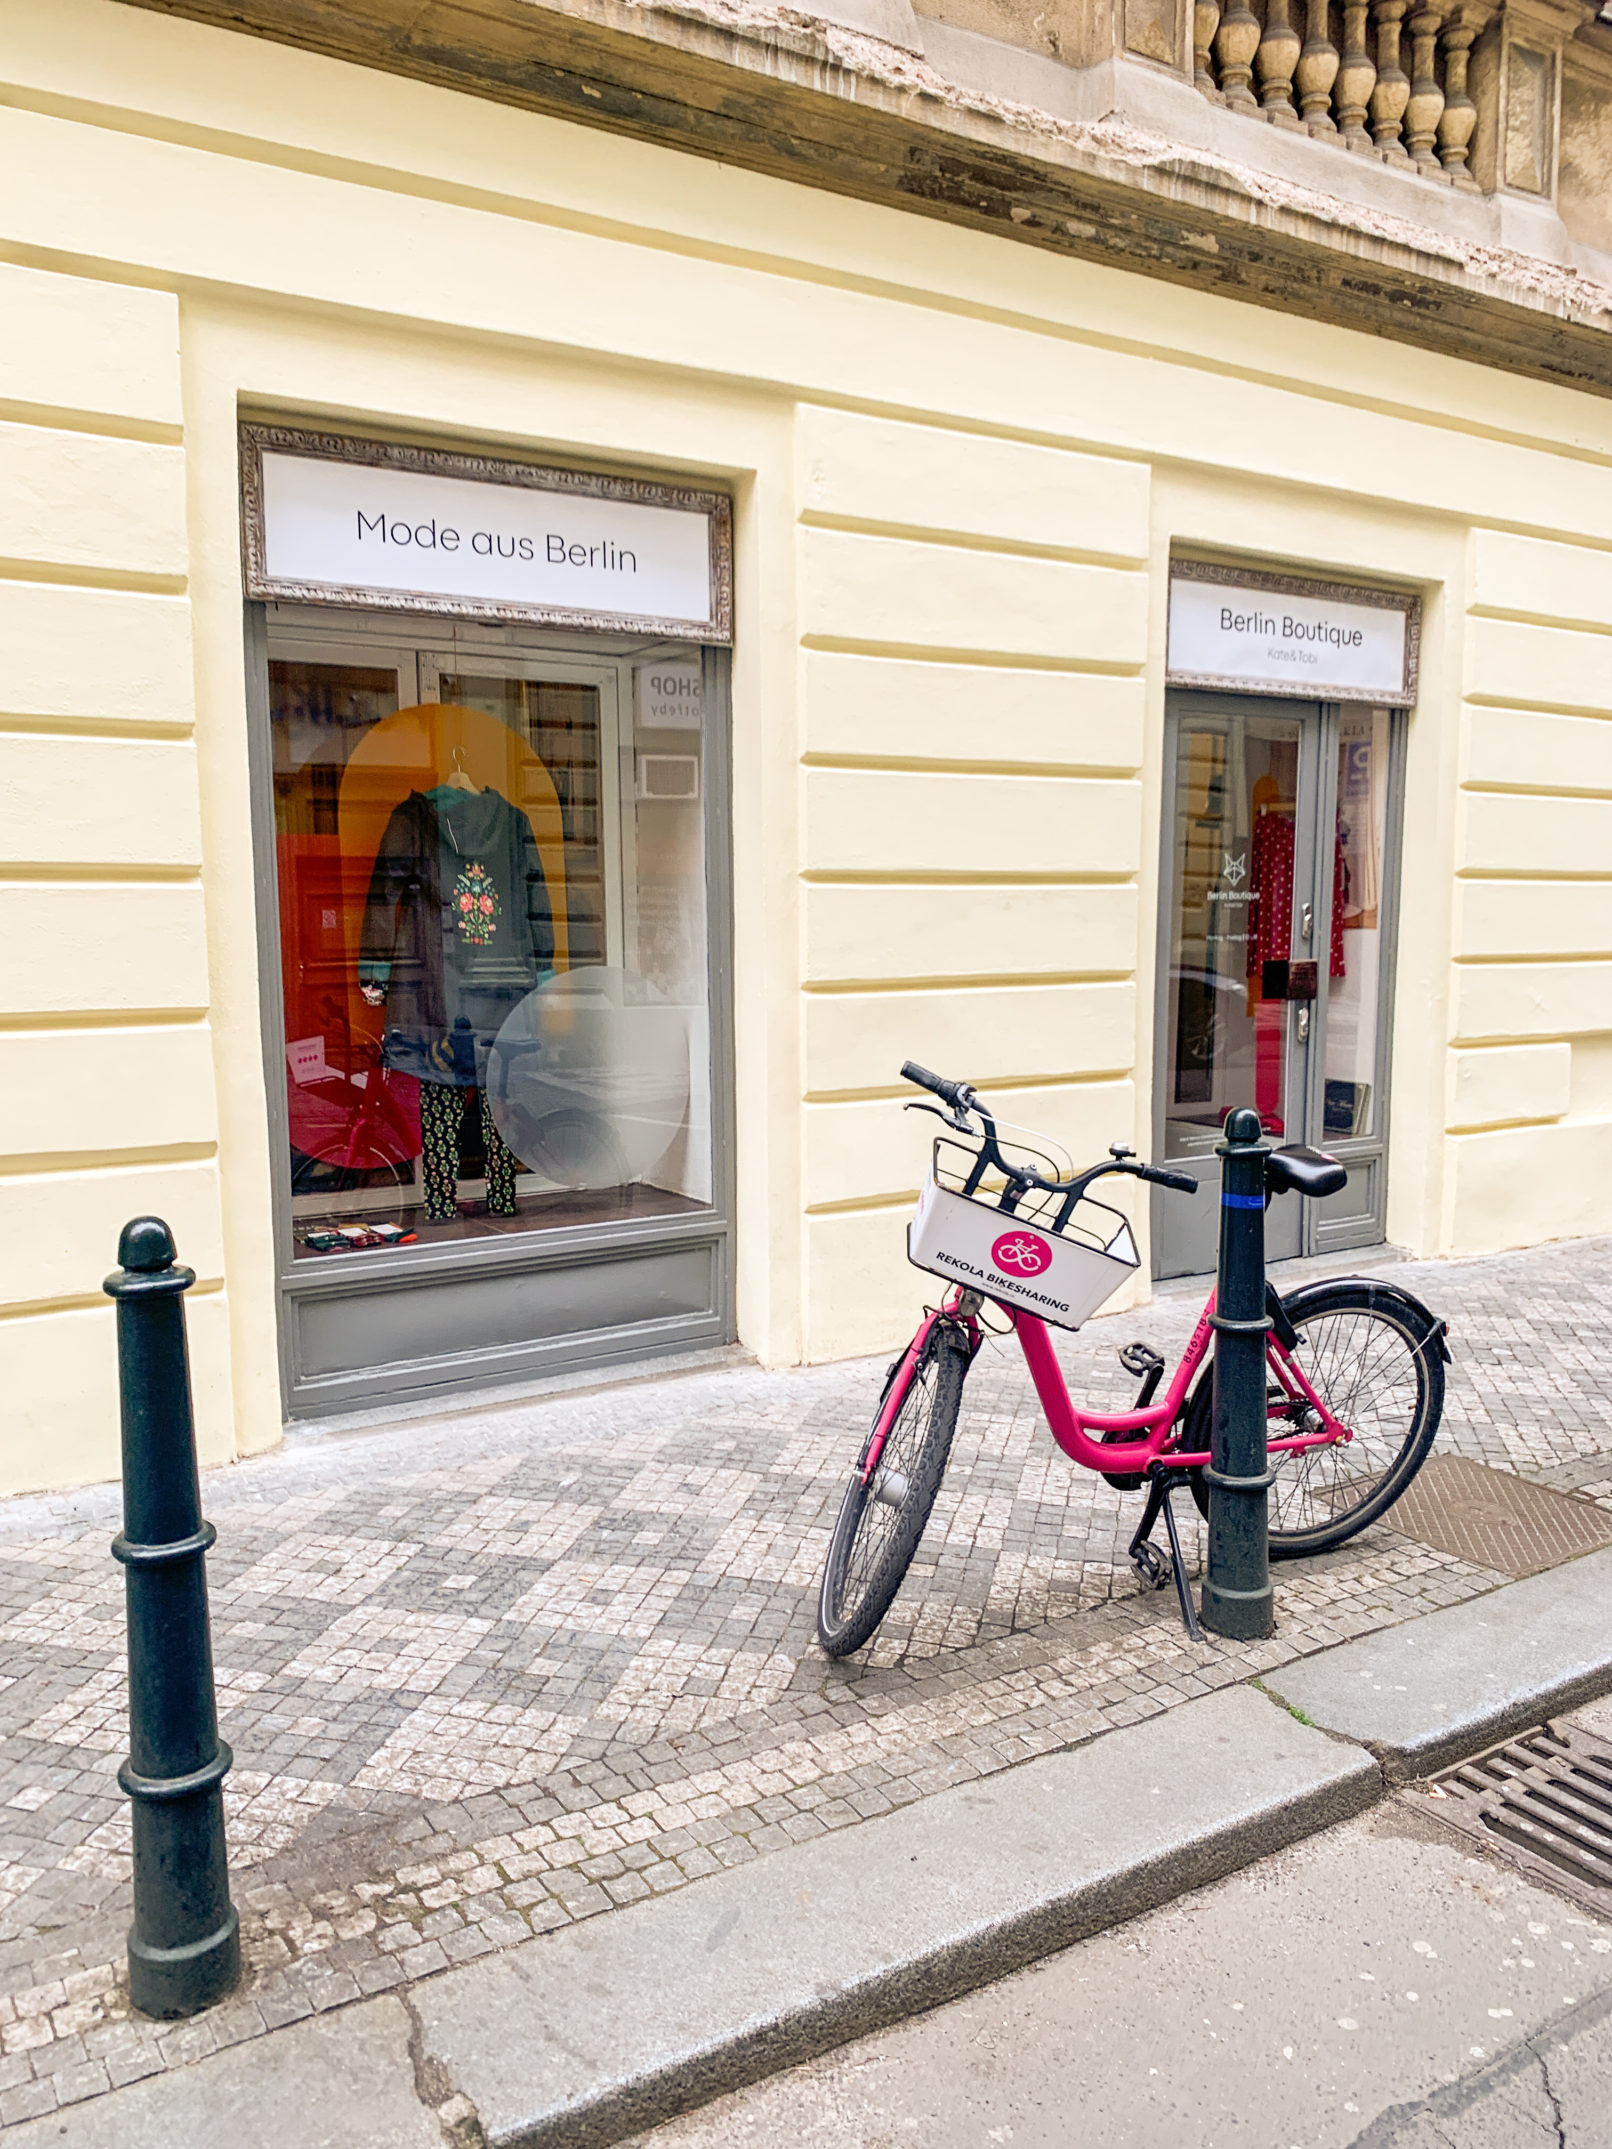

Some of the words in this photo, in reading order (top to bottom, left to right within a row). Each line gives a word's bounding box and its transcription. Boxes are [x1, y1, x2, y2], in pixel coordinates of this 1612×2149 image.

[356, 509, 461, 552] Mode
[471, 531, 534, 561] aus
[546, 533, 637, 574] Berlin
[1220, 607, 1276, 636] Berlin
[1282, 616, 1363, 649] Boutique
[1229, 891, 1260, 901] Boutique
[935, 1251, 985, 1279] REKOLA
[986, 1272, 1071, 1313] BIKESHARING
